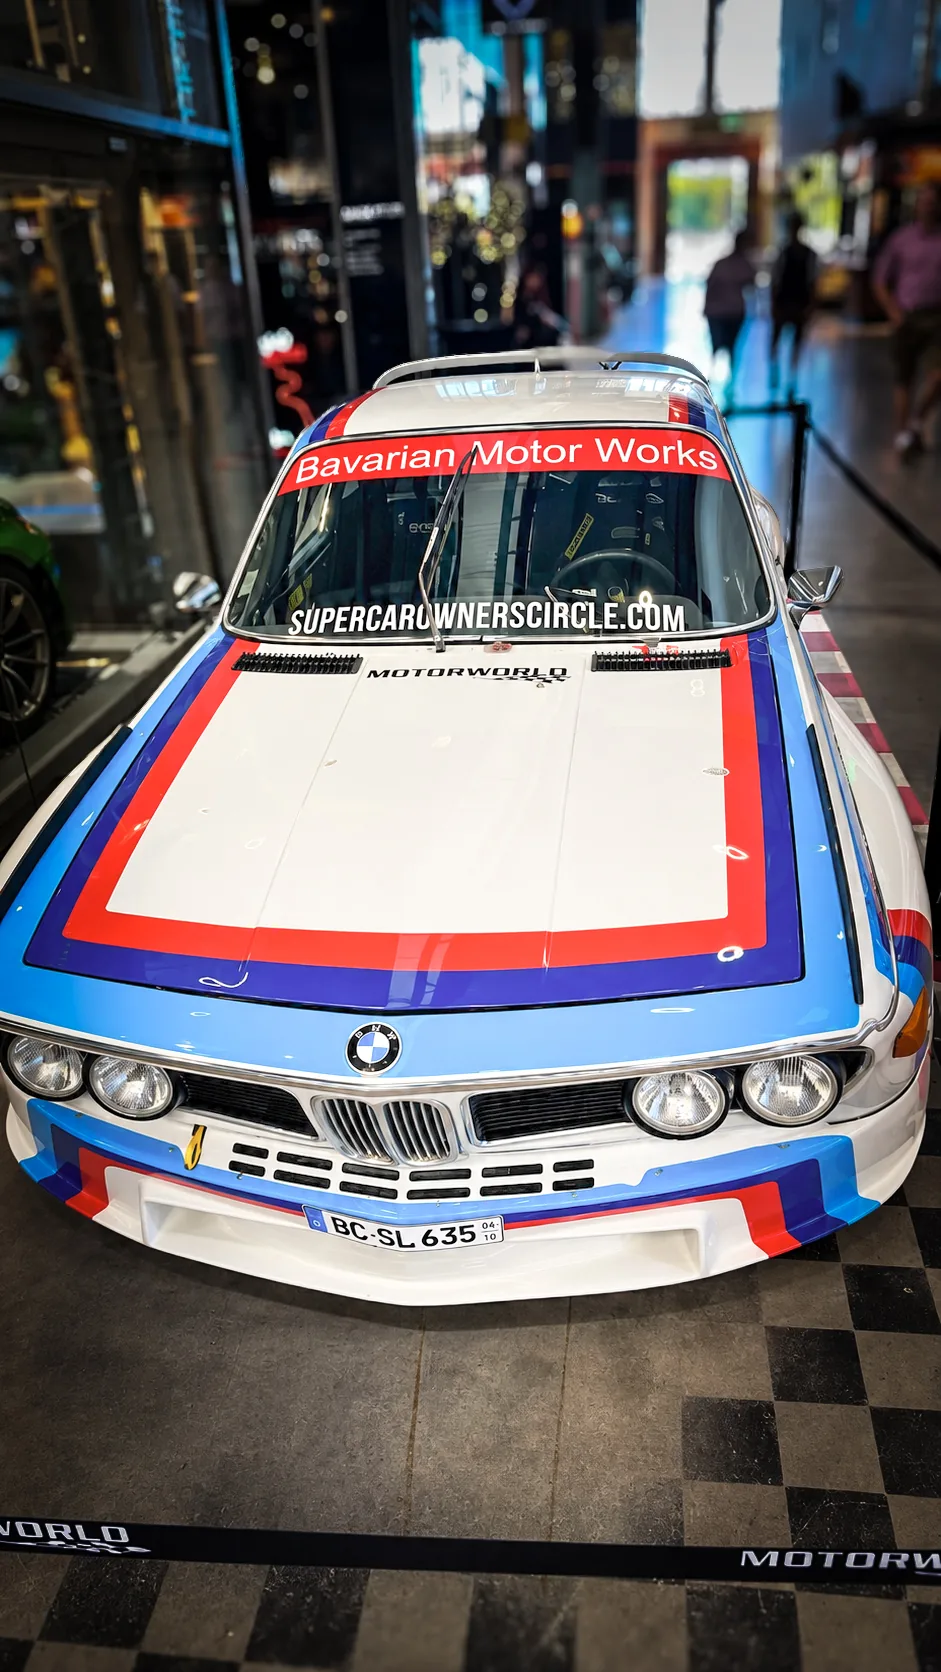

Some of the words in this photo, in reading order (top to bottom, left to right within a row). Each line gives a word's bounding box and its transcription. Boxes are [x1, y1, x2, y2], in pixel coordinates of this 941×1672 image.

[295, 445, 455, 484] Bavarian
[470, 440, 583, 465] Motor
[594, 437, 719, 471] Works
[288, 602, 685, 636] SUPERCAROWNERSCIRCLE.COM
[366, 667, 568, 679] MOTORWORLD
[481, 1221, 496, 1230] 04
[421, 1224, 476, 1248] 635
[484, 1233, 497, 1241] 10
